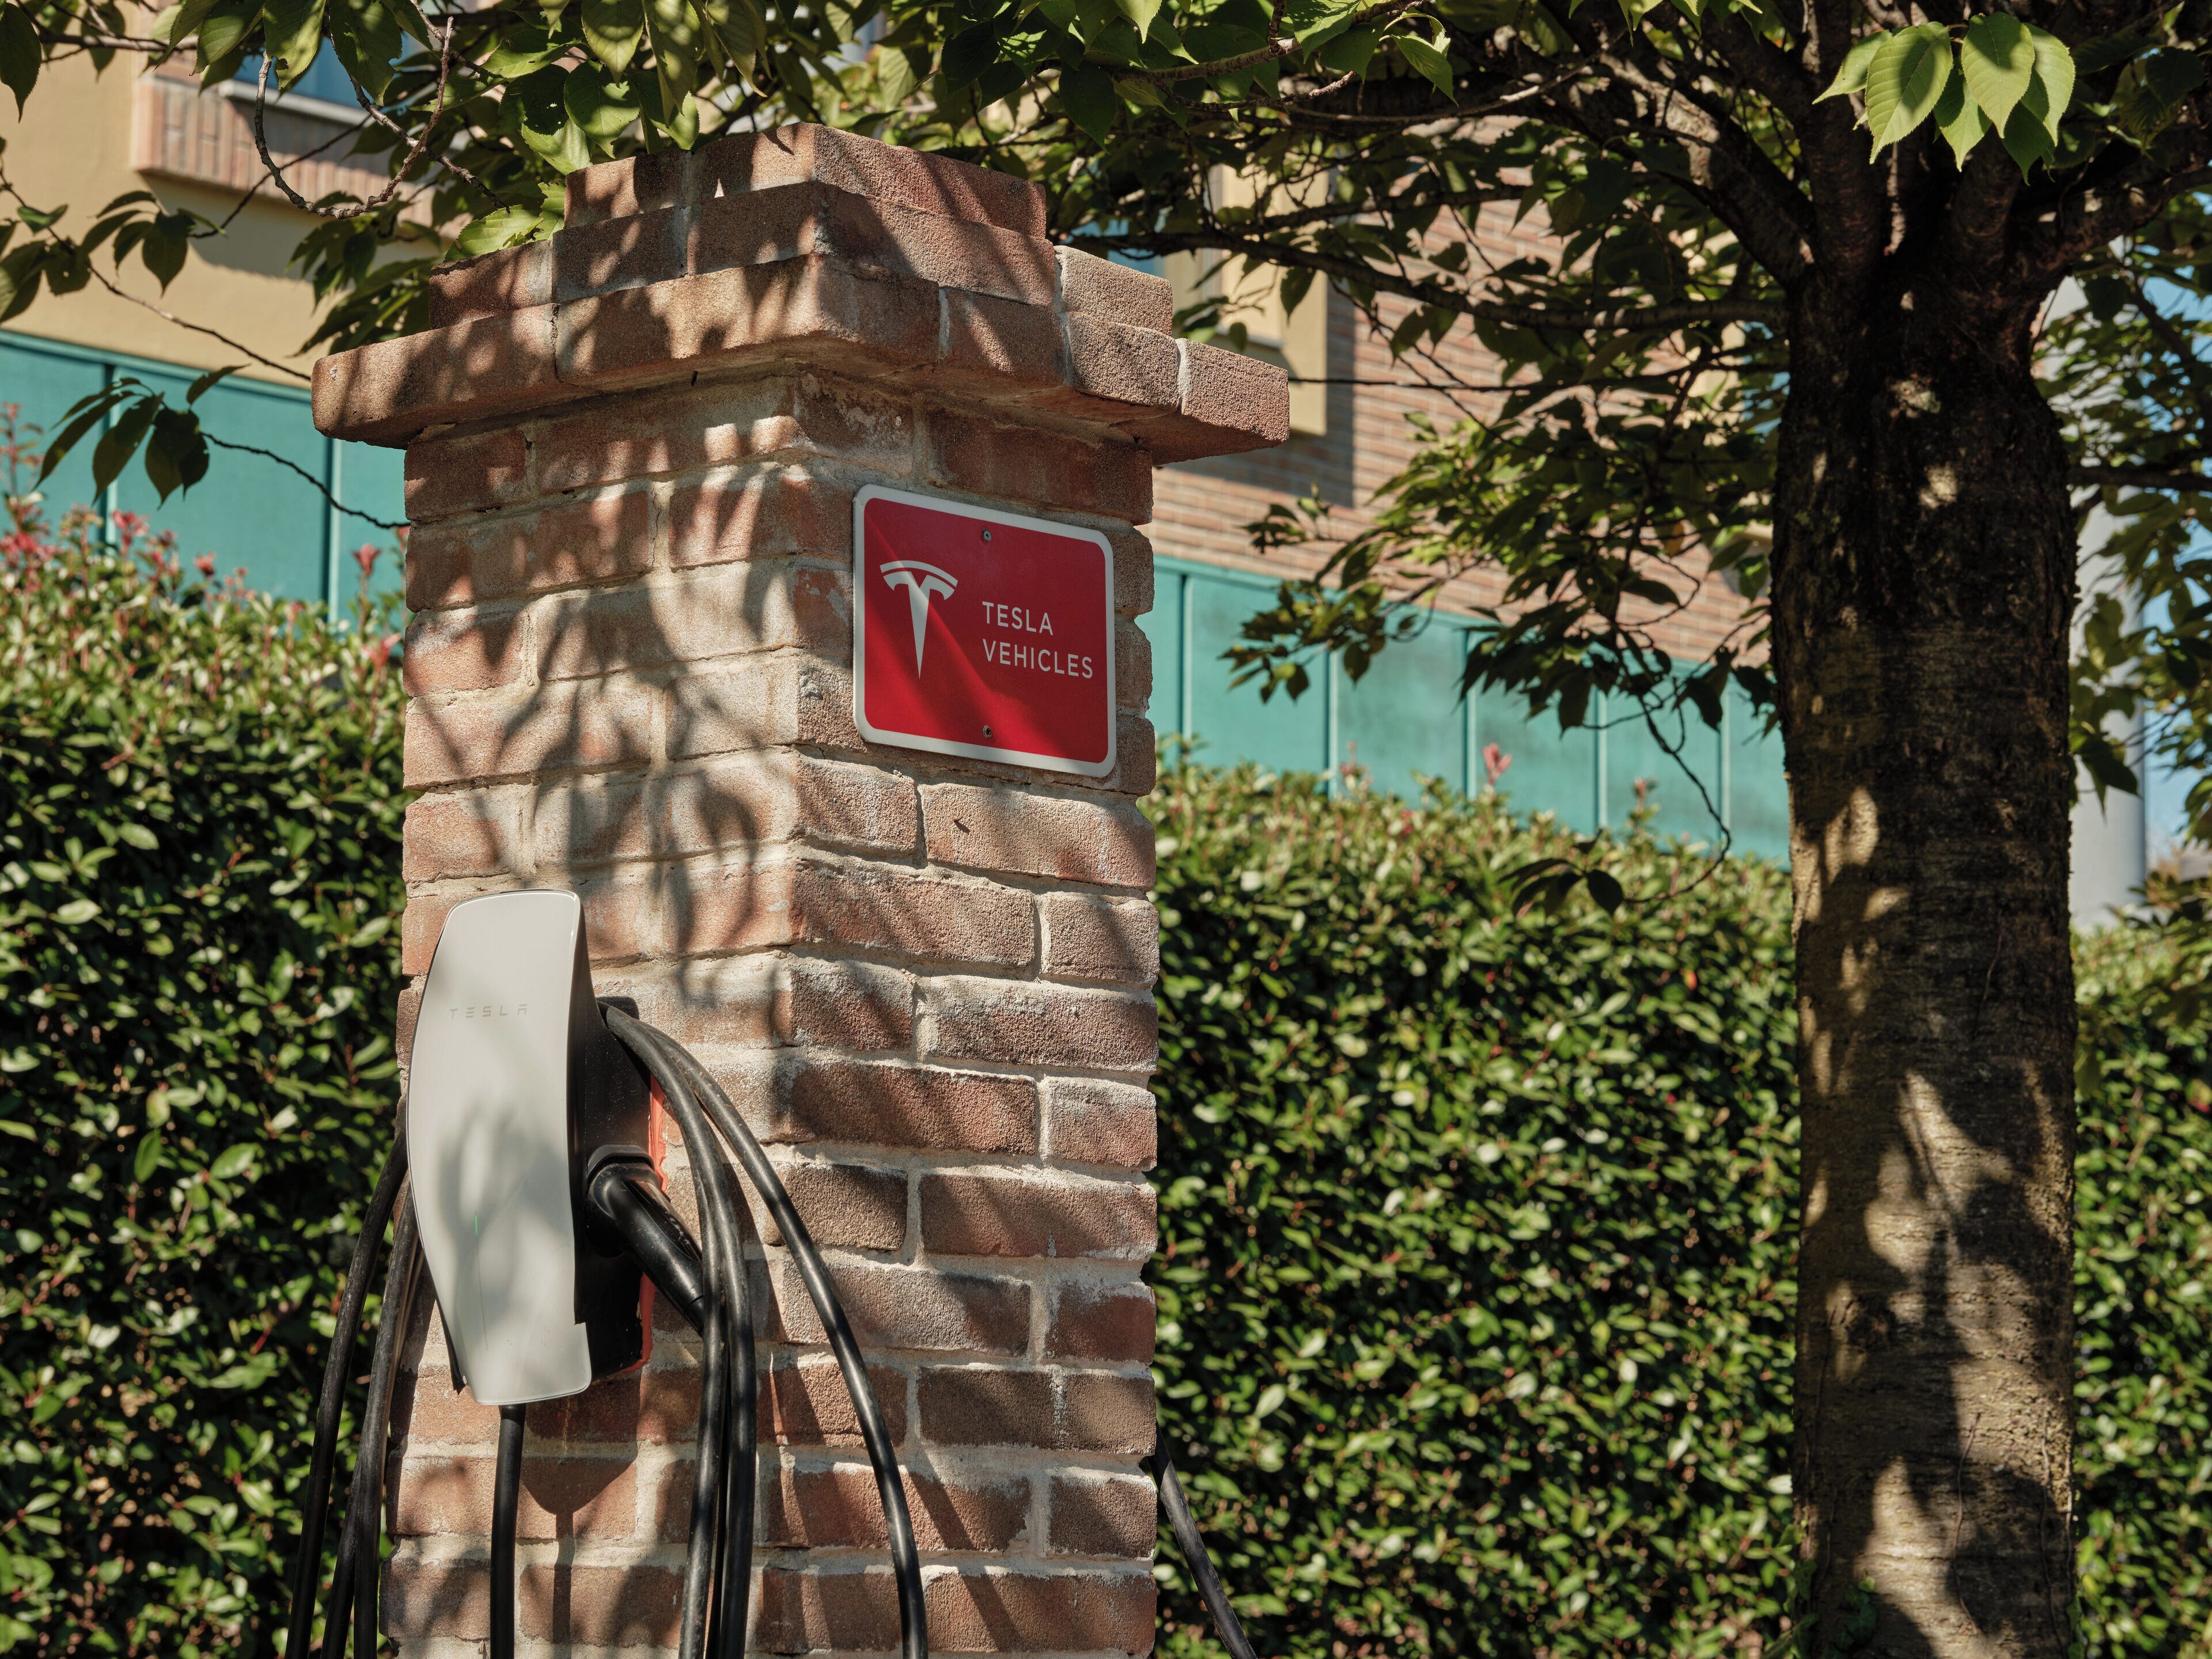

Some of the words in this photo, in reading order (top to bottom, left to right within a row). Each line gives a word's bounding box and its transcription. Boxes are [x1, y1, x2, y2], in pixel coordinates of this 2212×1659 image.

[982, 601, 1054, 635] TESLA
[982, 638, 1093, 679] VEHICLES
[449, 1003, 528, 1020] TESLA
